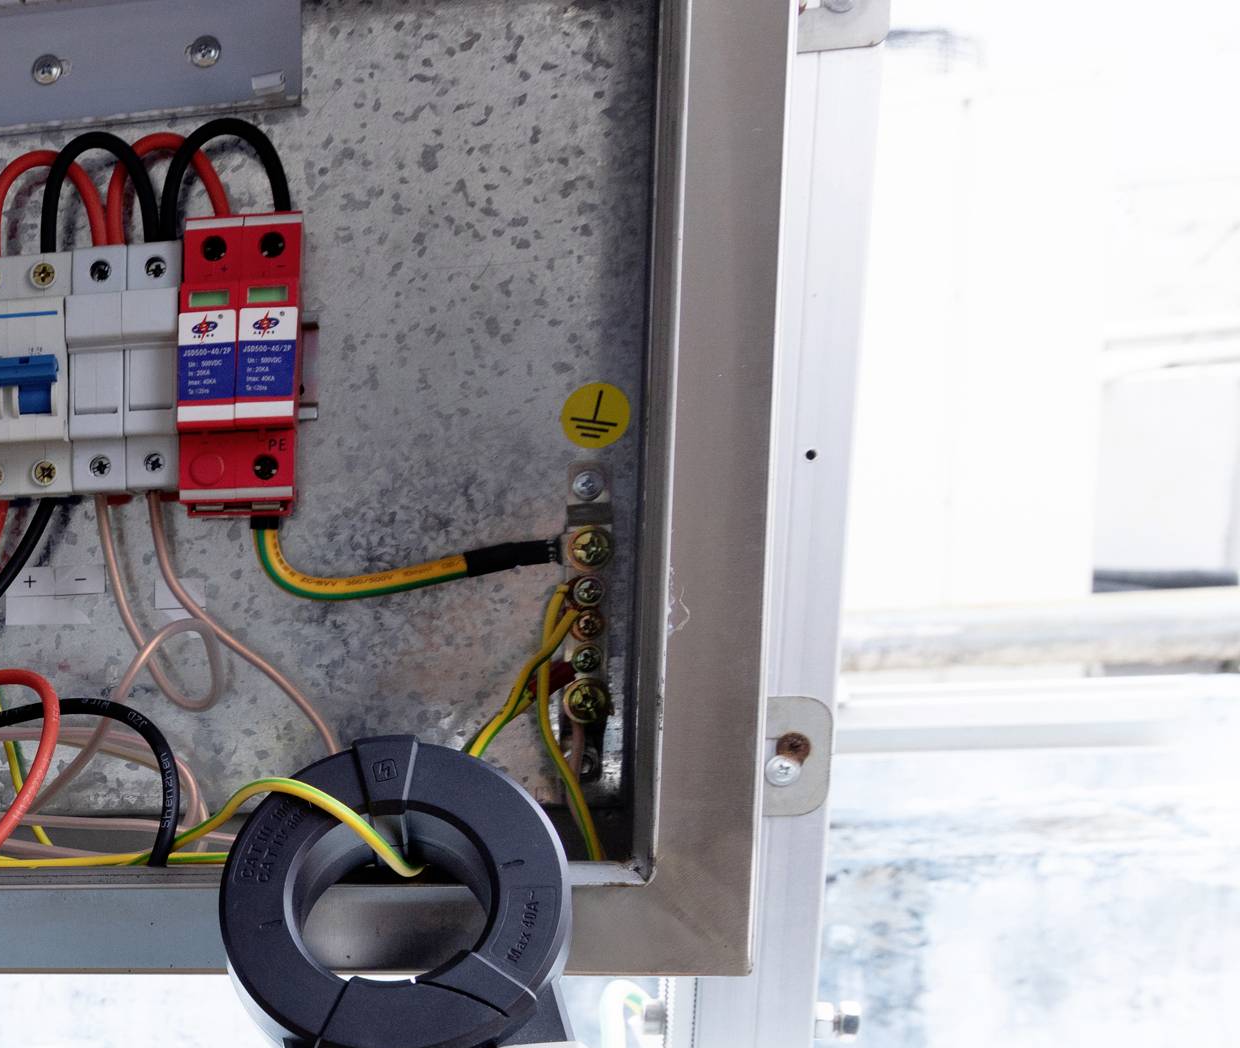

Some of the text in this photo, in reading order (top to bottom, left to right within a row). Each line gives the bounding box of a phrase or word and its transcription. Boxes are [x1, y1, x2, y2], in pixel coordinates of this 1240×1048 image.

[268, 438, 287, 452] PE
[241, 844, 262, 878] CAT
[257, 848, 277, 882] CAT
[504, 932, 531, 962] Max
